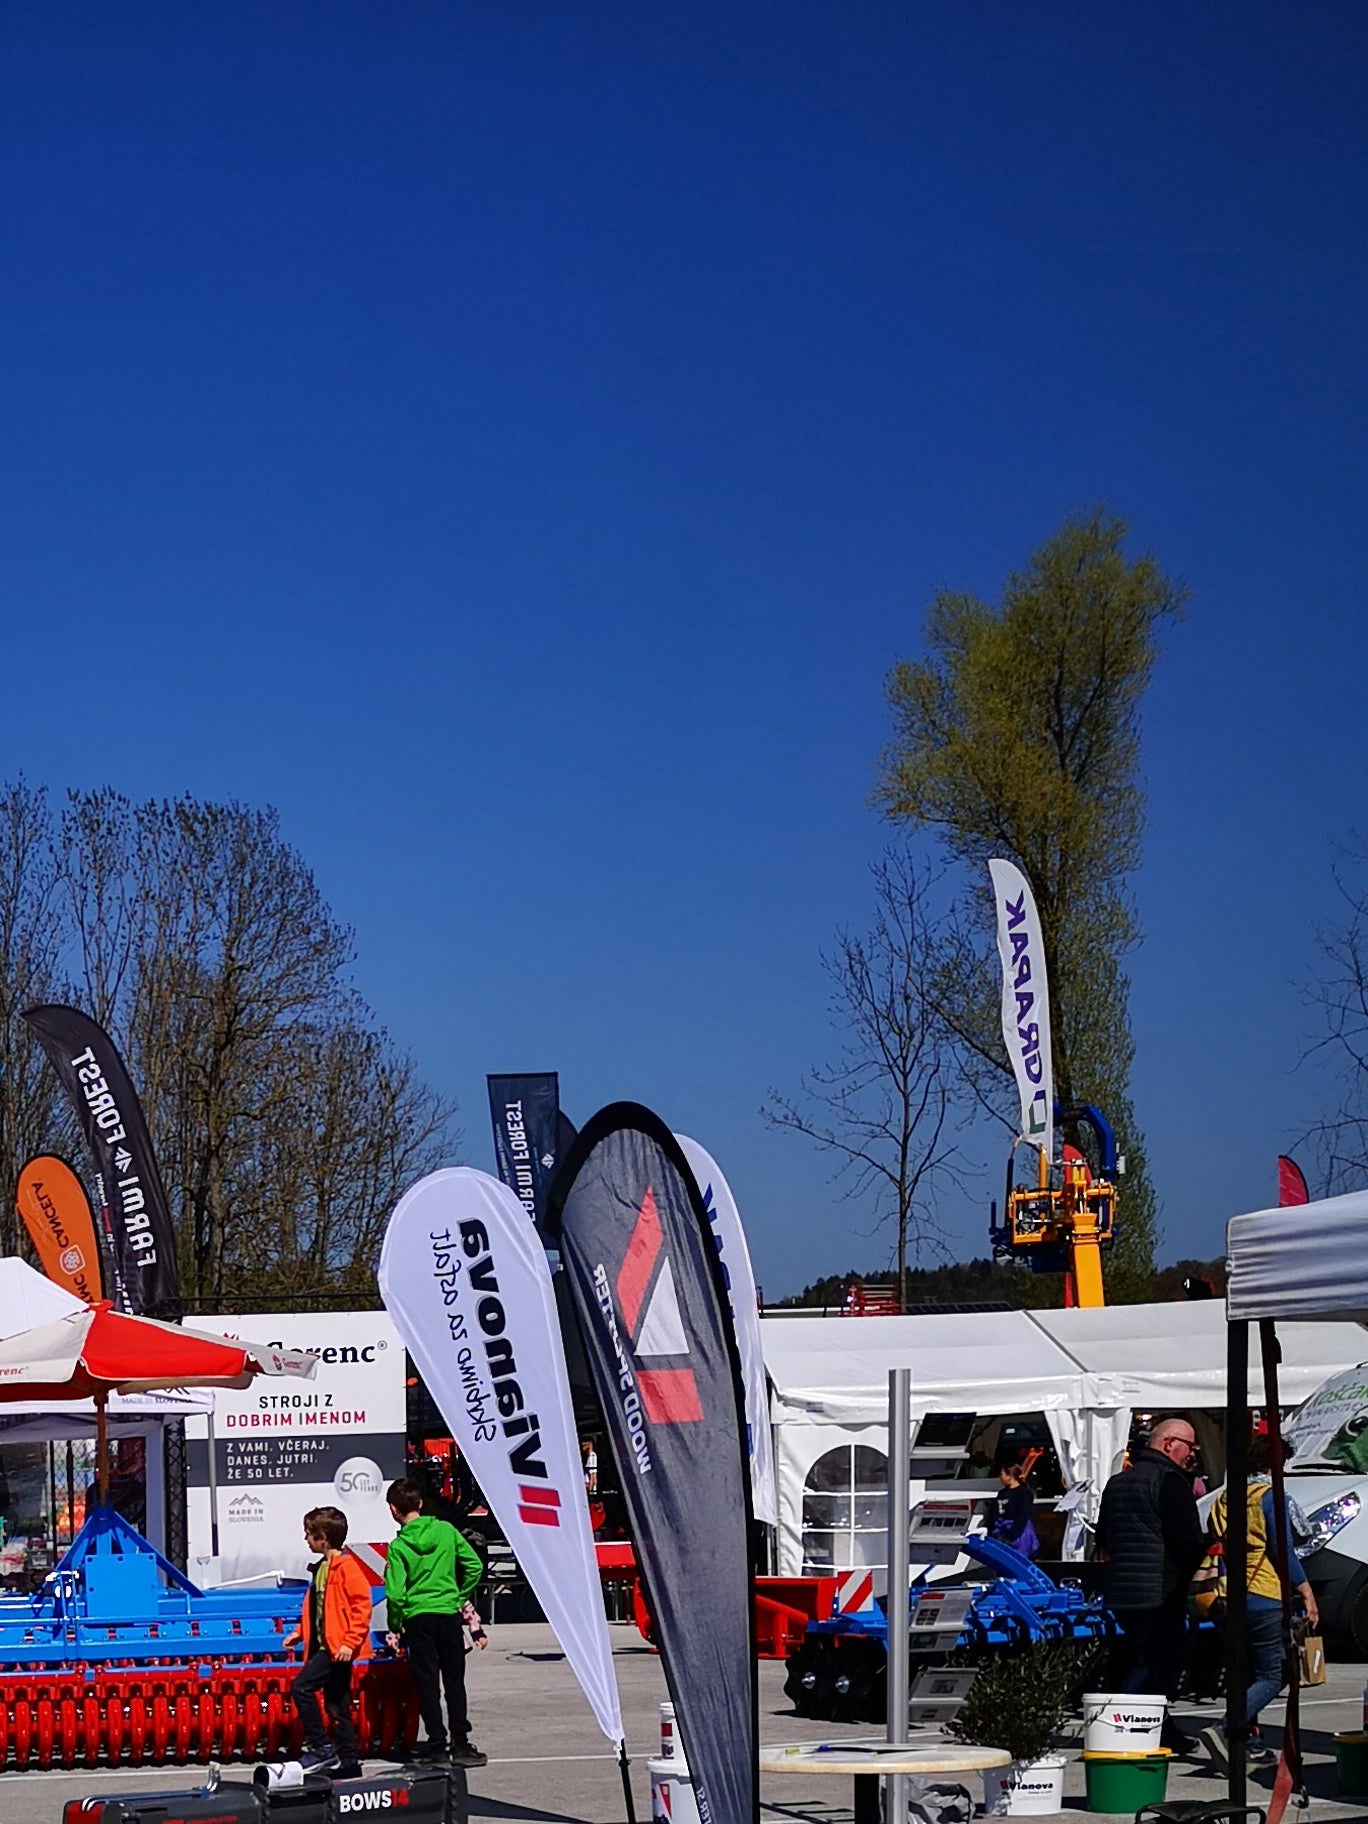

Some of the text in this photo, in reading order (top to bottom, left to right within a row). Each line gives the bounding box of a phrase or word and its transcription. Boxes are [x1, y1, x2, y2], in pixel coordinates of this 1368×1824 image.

[259, 1394, 333, 1409] STROJI Z
[226, 1411, 366, 1427] DOBRIM IMENOM
[226, 1439, 330, 1453] Z VAMI. VČERAJ.
[227, 1453, 318, 1466] DANES. JUTRI.
[226, 1466, 295, 1480] ŽE 50 LET.
[339, 1788, 409, 1814] BOWS14
